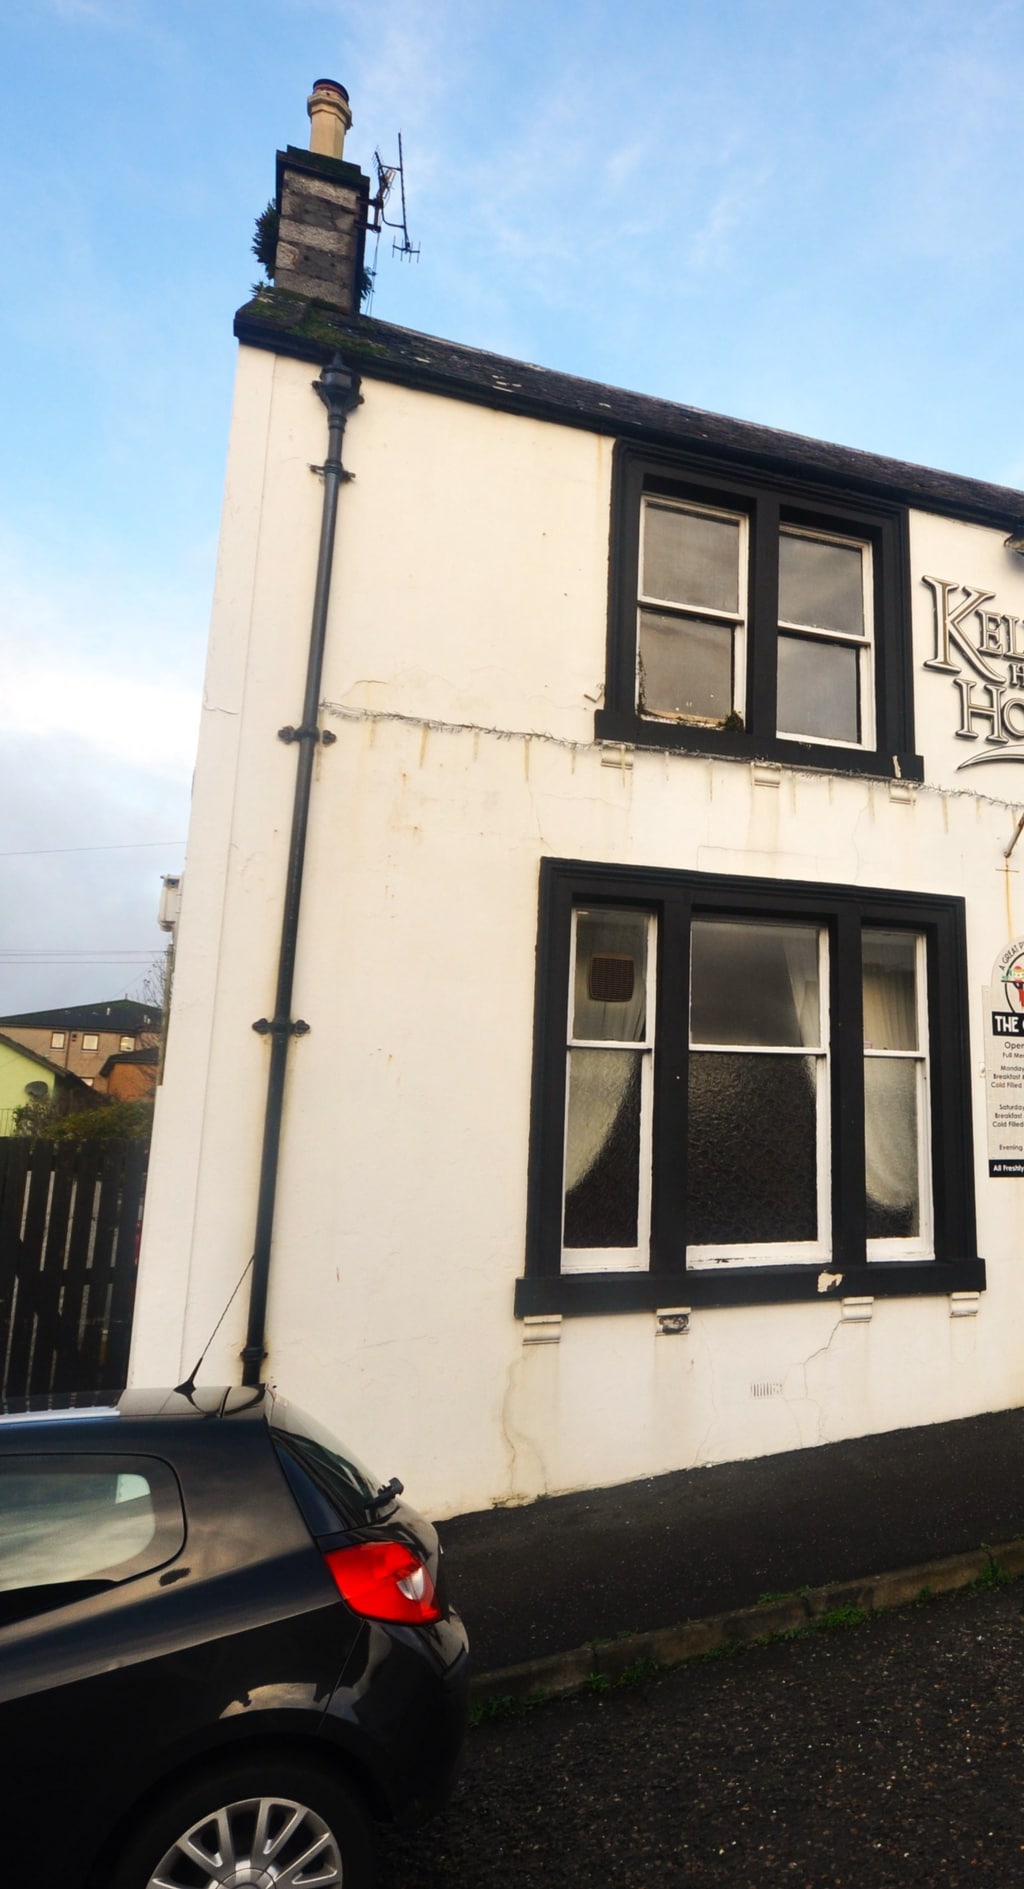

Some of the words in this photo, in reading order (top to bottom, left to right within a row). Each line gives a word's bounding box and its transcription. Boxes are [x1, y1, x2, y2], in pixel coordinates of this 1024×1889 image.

[1002, 945, 1019, 964] GREAT
[994, 1016, 1019, 1033] THE
[1000, 1065, 1024, 1073] Monday
[1003, 1165, 1024, 1173] Freshly
